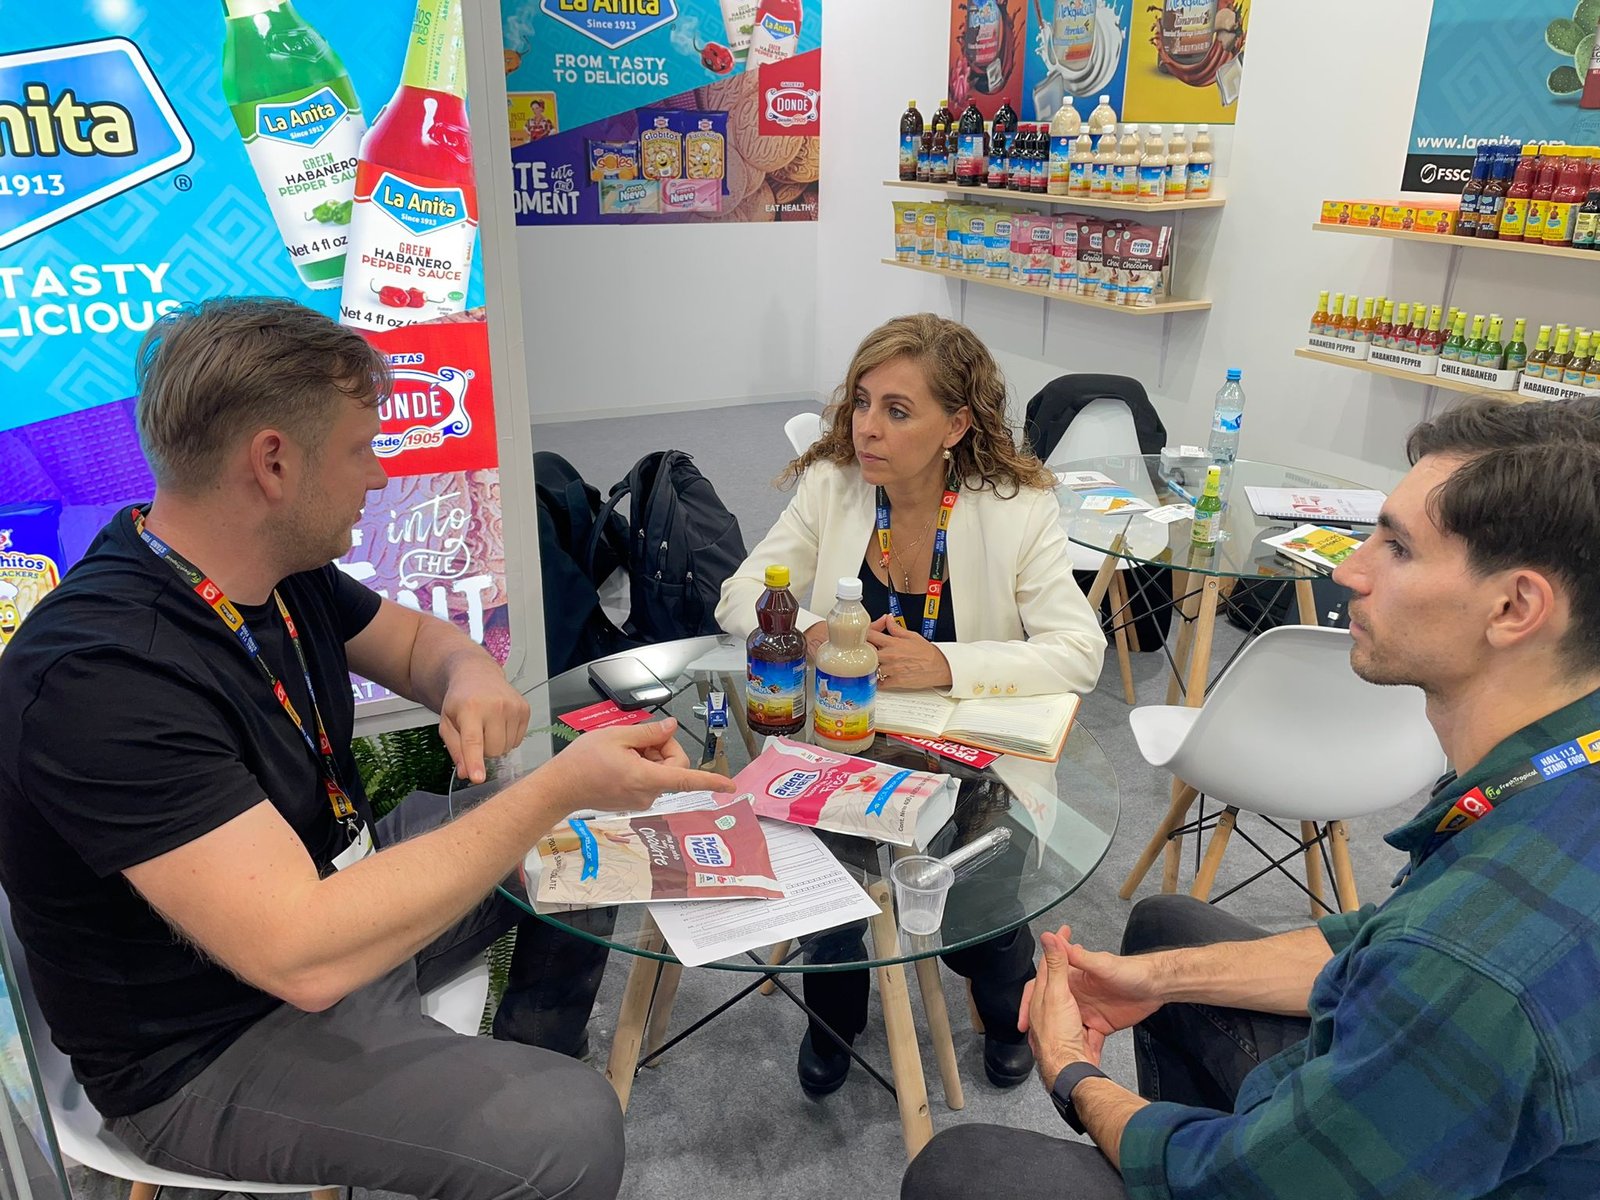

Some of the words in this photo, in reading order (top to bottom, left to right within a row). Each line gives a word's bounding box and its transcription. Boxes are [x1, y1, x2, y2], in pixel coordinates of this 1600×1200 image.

[587, 18, 614, 29] Since
[614, 20, 638, 31] 1913
[555, 53, 603, 69] FROM
[608, 55, 667, 71] TASTY
[552, 68, 578, 84] TO
[584, 70, 670, 87] DELICIOUS
[776, 95, 808, 113] DONDÉ
[264, 114, 289, 133] La
[288, 103, 337, 129] Anita
[290, 130, 309, 139] Since
[309, 125, 325, 136] 1913
[643, 131, 679, 141] Globitos
[302, 152, 335, 170] GREEN
[285, 157, 358, 185] HABANERO
[512, 162, 549, 190] TE
[550, 164, 575, 180] into
[1436, 168, 1472, 181] FSSC
[278, 179, 328, 197] PEPPER
[620, 188, 647, 203] Nieve
[384, 185, 405, 208] La
[407, 192, 457, 219] Anita
[670, 191, 696, 204] Nieve
[765, 204, 780, 212] EAT
[781, 203, 816, 212] HEALTHY
[401, 212, 420, 224] Since
[420, 217, 437, 226] 1913
[286, 243, 311, 258] Net
[311, 241, 320, 252] 4
[321, 238, 331, 250] fl
[332, 235, 348, 247] oz
[399, 242, 432, 257] GREEN
[361, 254, 412, 275] PEPPER
[417, 267, 462, 281] SAUCE
[374, 247, 452, 270] HABANERO
[1122, 261, 1153, 270] Chocolate
[0, 262, 170, 299] TASTY
[340, 305, 360, 320] Net
[364, 312, 373, 322] 4
[376, 314, 384, 325] fl
[1308, 338, 1336, 351] HABANERO
[1335, 343, 1356, 354] PEPPER
[1371, 351, 1400, 364] HABANERO
[1400, 356, 1422, 368] PEPPER
[1441, 363, 1460, 376] CHILE
[1460, 366, 1498, 382] HABANERO
[1523, 381, 1560, 396] HABANERO
[407, 431, 441, 445] 1905
[388, 491, 472, 544] into
[150, 540, 167, 554] STAND
[414, 553, 457, 574] THE
[901, 735, 978, 762] PRODU
[1540, 754, 1560, 767] HALL
[1561, 747, 1577, 760] 11.3
[1543, 762, 1568, 776] STAND
[774, 772, 806, 796] avena
[1499, 769, 1538, 791] FreshTropical
[547, 837, 560, 856] POLVO
[702, 836, 724, 865] avena
